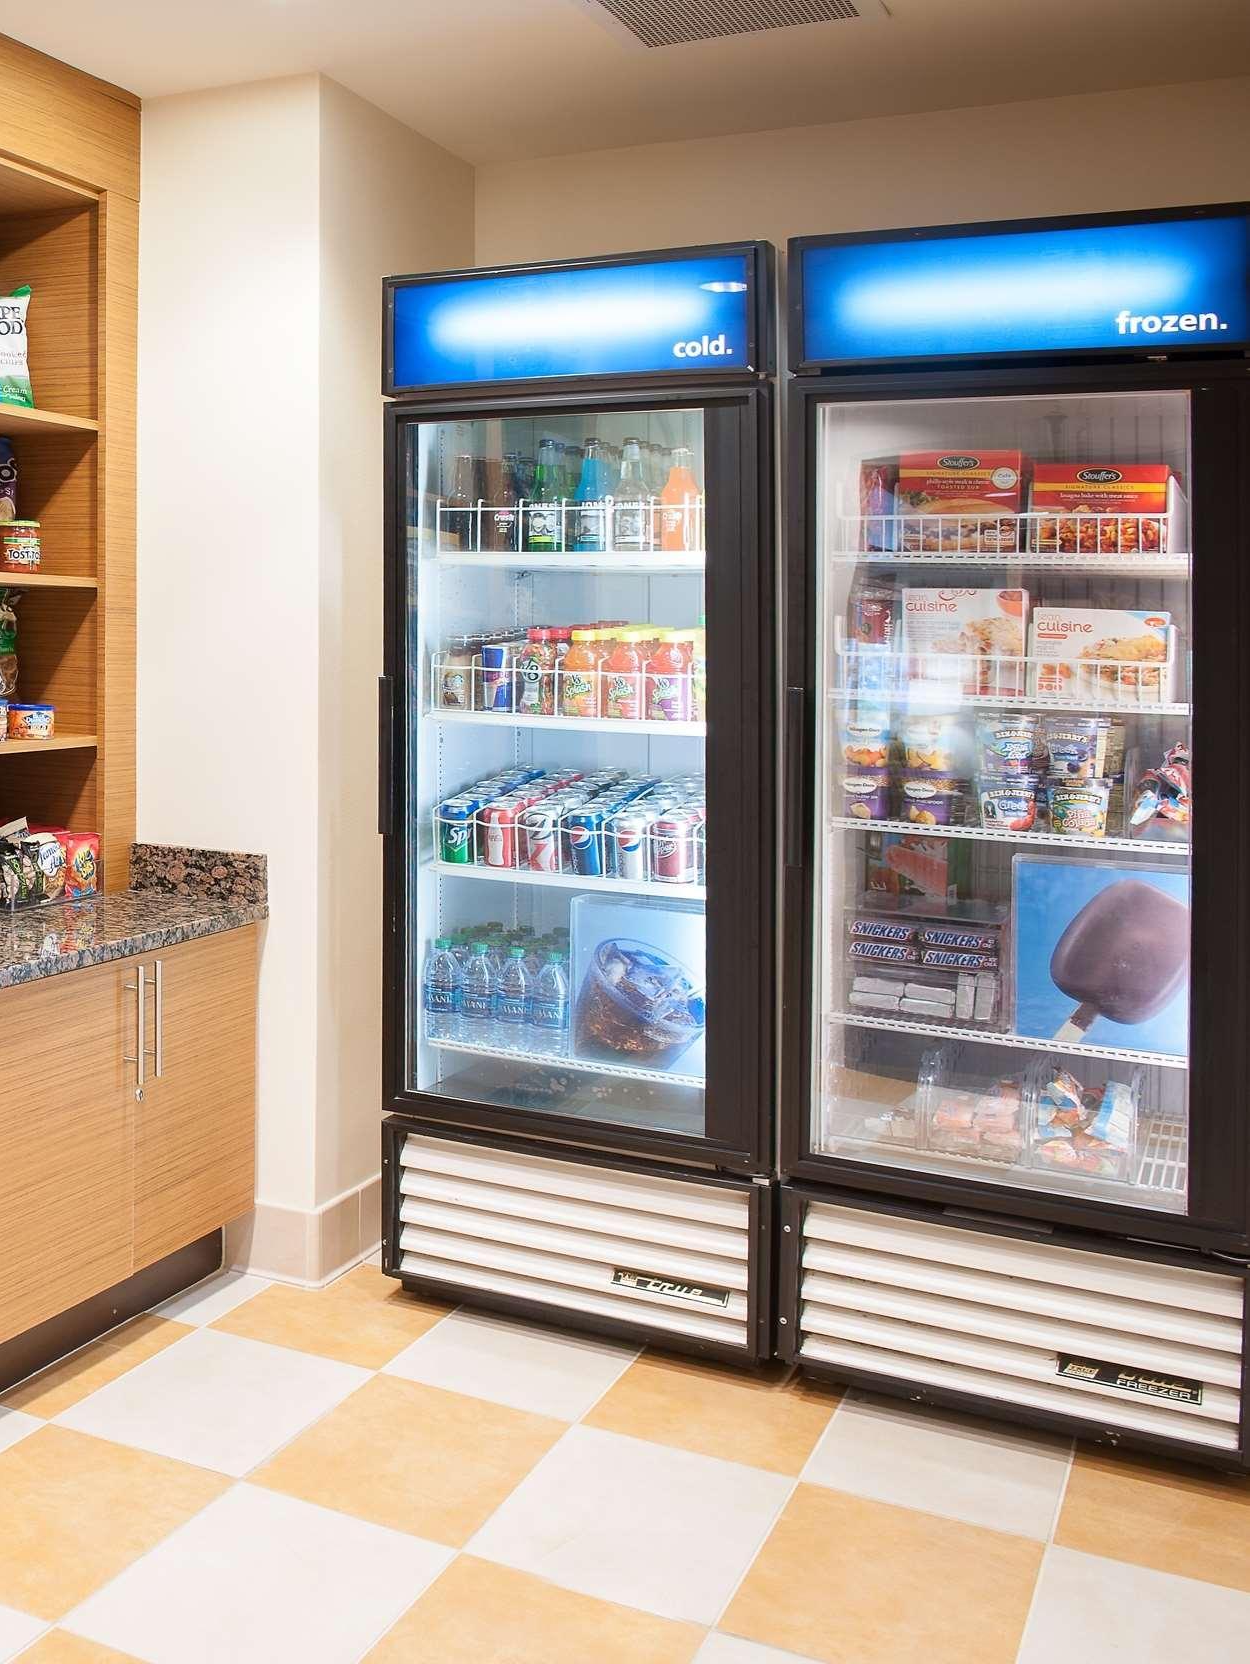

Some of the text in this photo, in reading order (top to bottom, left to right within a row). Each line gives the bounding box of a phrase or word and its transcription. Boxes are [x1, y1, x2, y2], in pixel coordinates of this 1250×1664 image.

[1115, 309, 1229, 335] frozen.
[672, 334, 734, 359] cold.
[1082, 471, 1117, 481] Stouffer's
[905, 600, 958, 612] cuisine
[1037, 620, 1094, 633] cuisine
[852, 921, 910, 940] SNICKERS
[924, 930, 982, 949] SNICKERS
[851, 942, 907, 961] SNICKERS
[925, 951, 984, 968] SNICKERS
[1116, 1377, 1192, 1401] FREEZER
